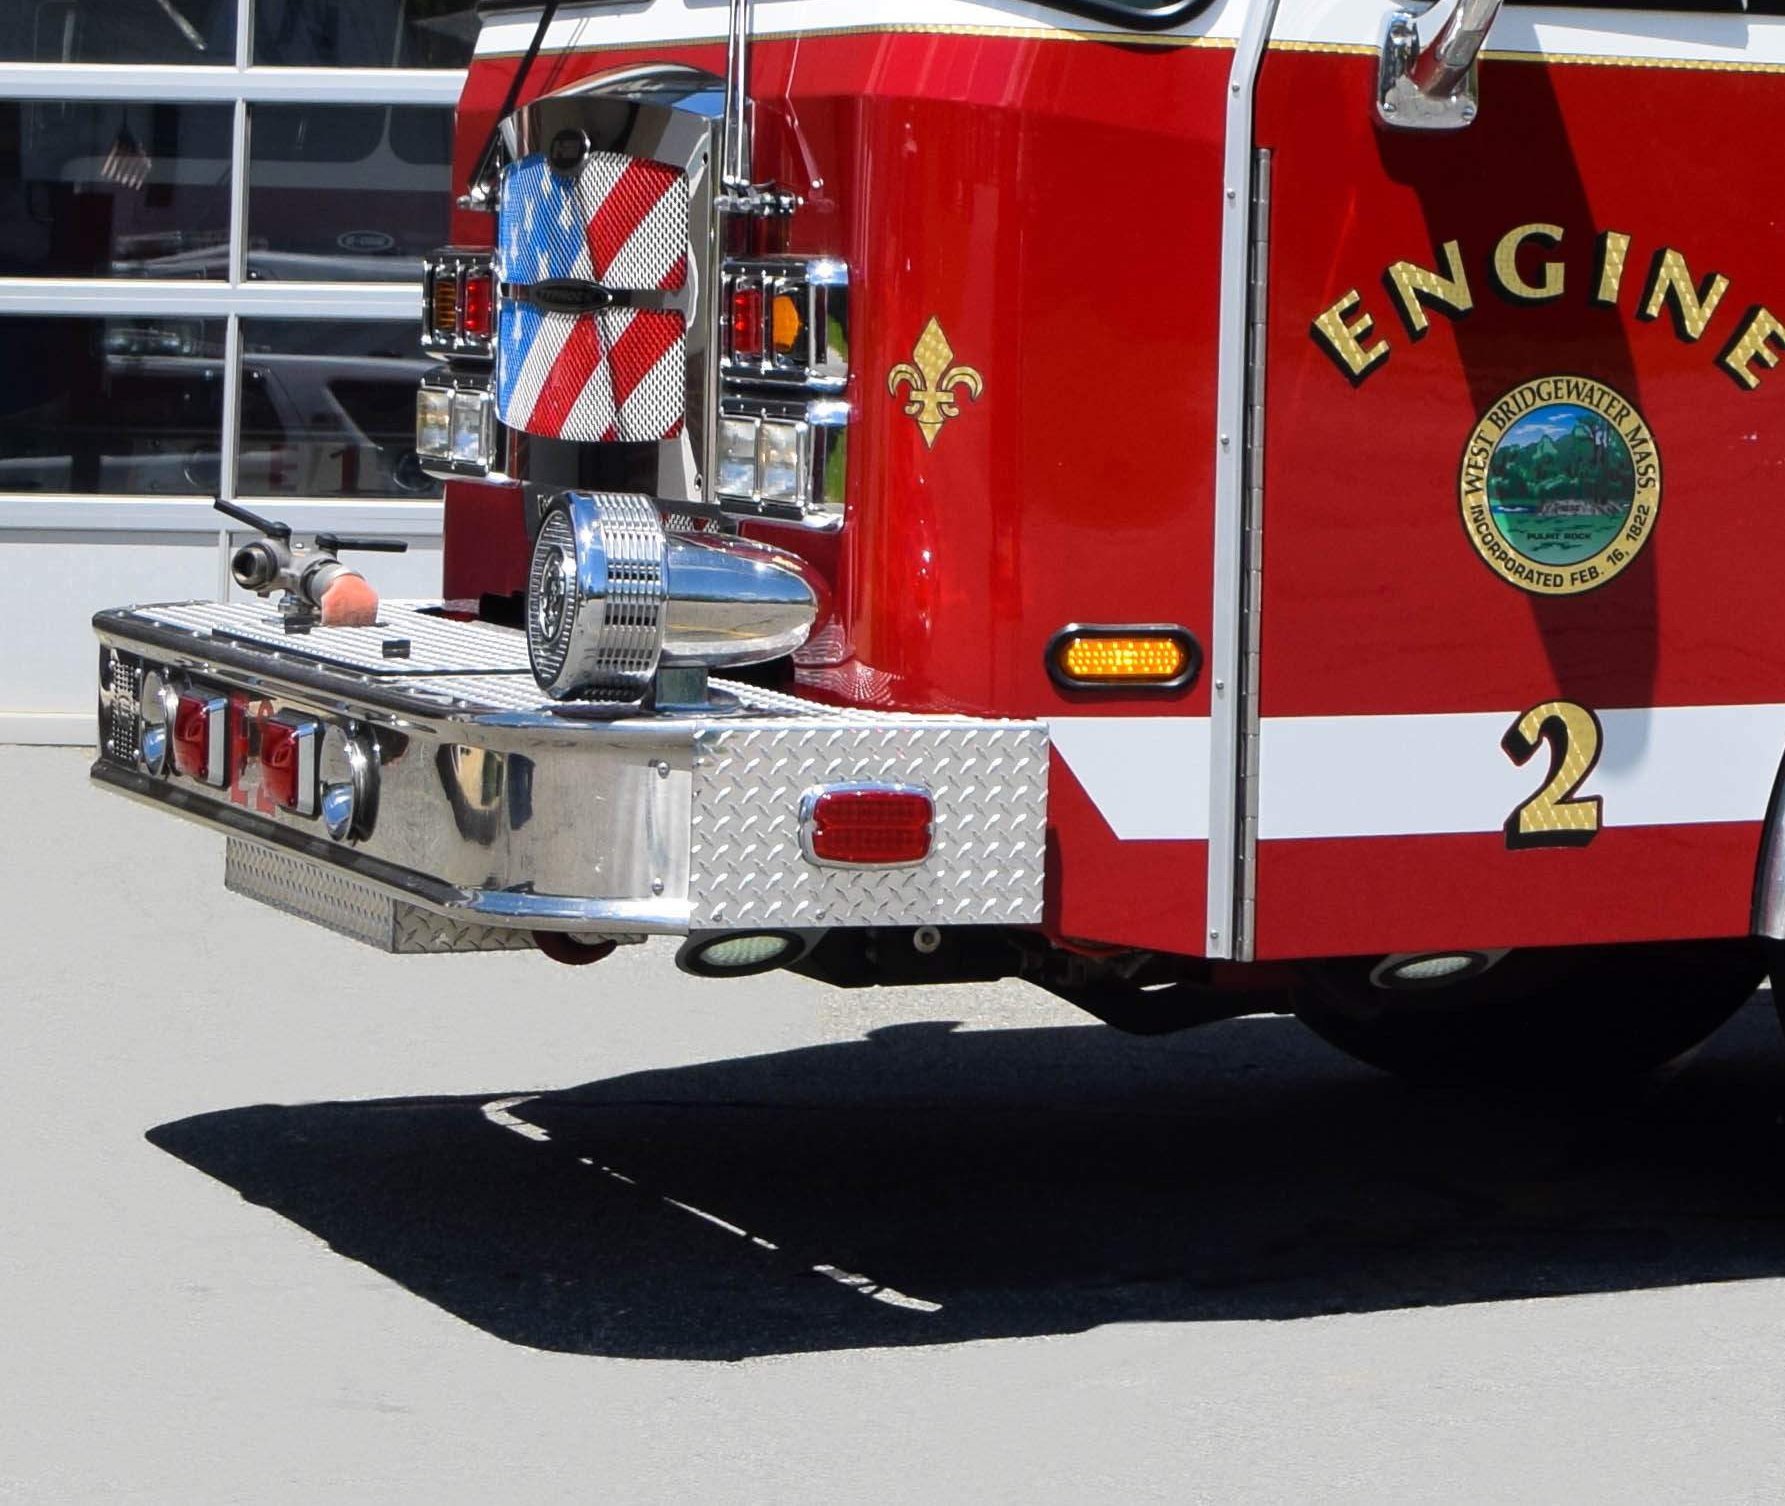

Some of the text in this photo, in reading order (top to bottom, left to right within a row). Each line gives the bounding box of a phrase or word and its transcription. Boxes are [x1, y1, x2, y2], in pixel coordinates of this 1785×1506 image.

[1464, 378, 1656, 496] WEST BRIDGEWATER MASS.
[1471, 503, 1564, 588] INCORPORATED
[1570, 565, 1605, 586] FEB.
[1625, 504, 1650, 543] 1822
[1501, 700, 1604, 851] 2
